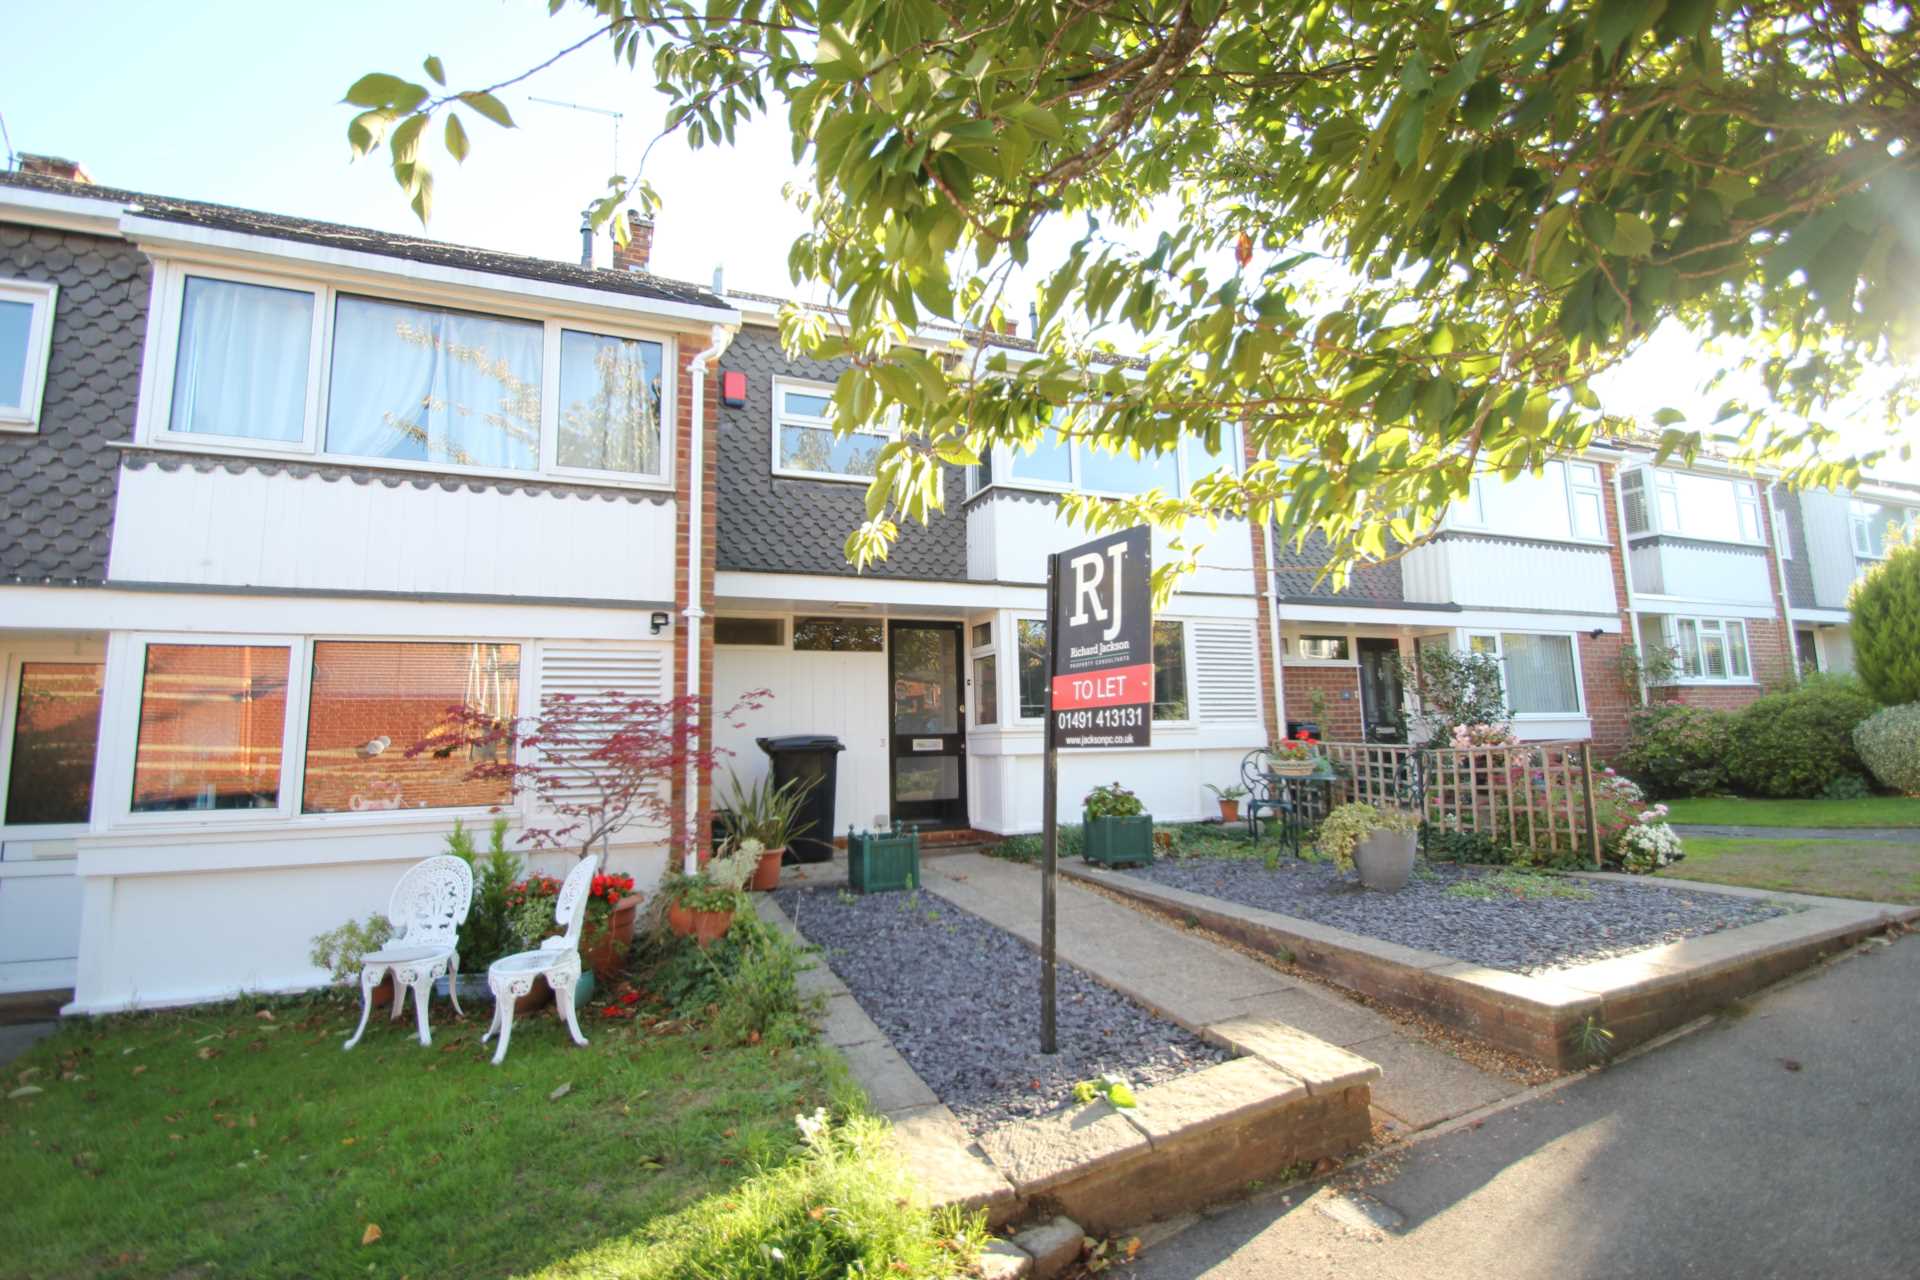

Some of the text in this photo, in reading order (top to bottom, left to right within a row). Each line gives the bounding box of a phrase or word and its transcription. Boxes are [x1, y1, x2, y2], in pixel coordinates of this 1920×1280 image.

[1069, 541, 1128, 641] RJ
[1070, 641, 1129, 658] Richard Jackson
[1072, 676, 1126, 701] TO LET
[1058, 708, 1142, 729] 01491 413131
[1066, 734, 1134, 746] www.jacksonpc.co.uk
